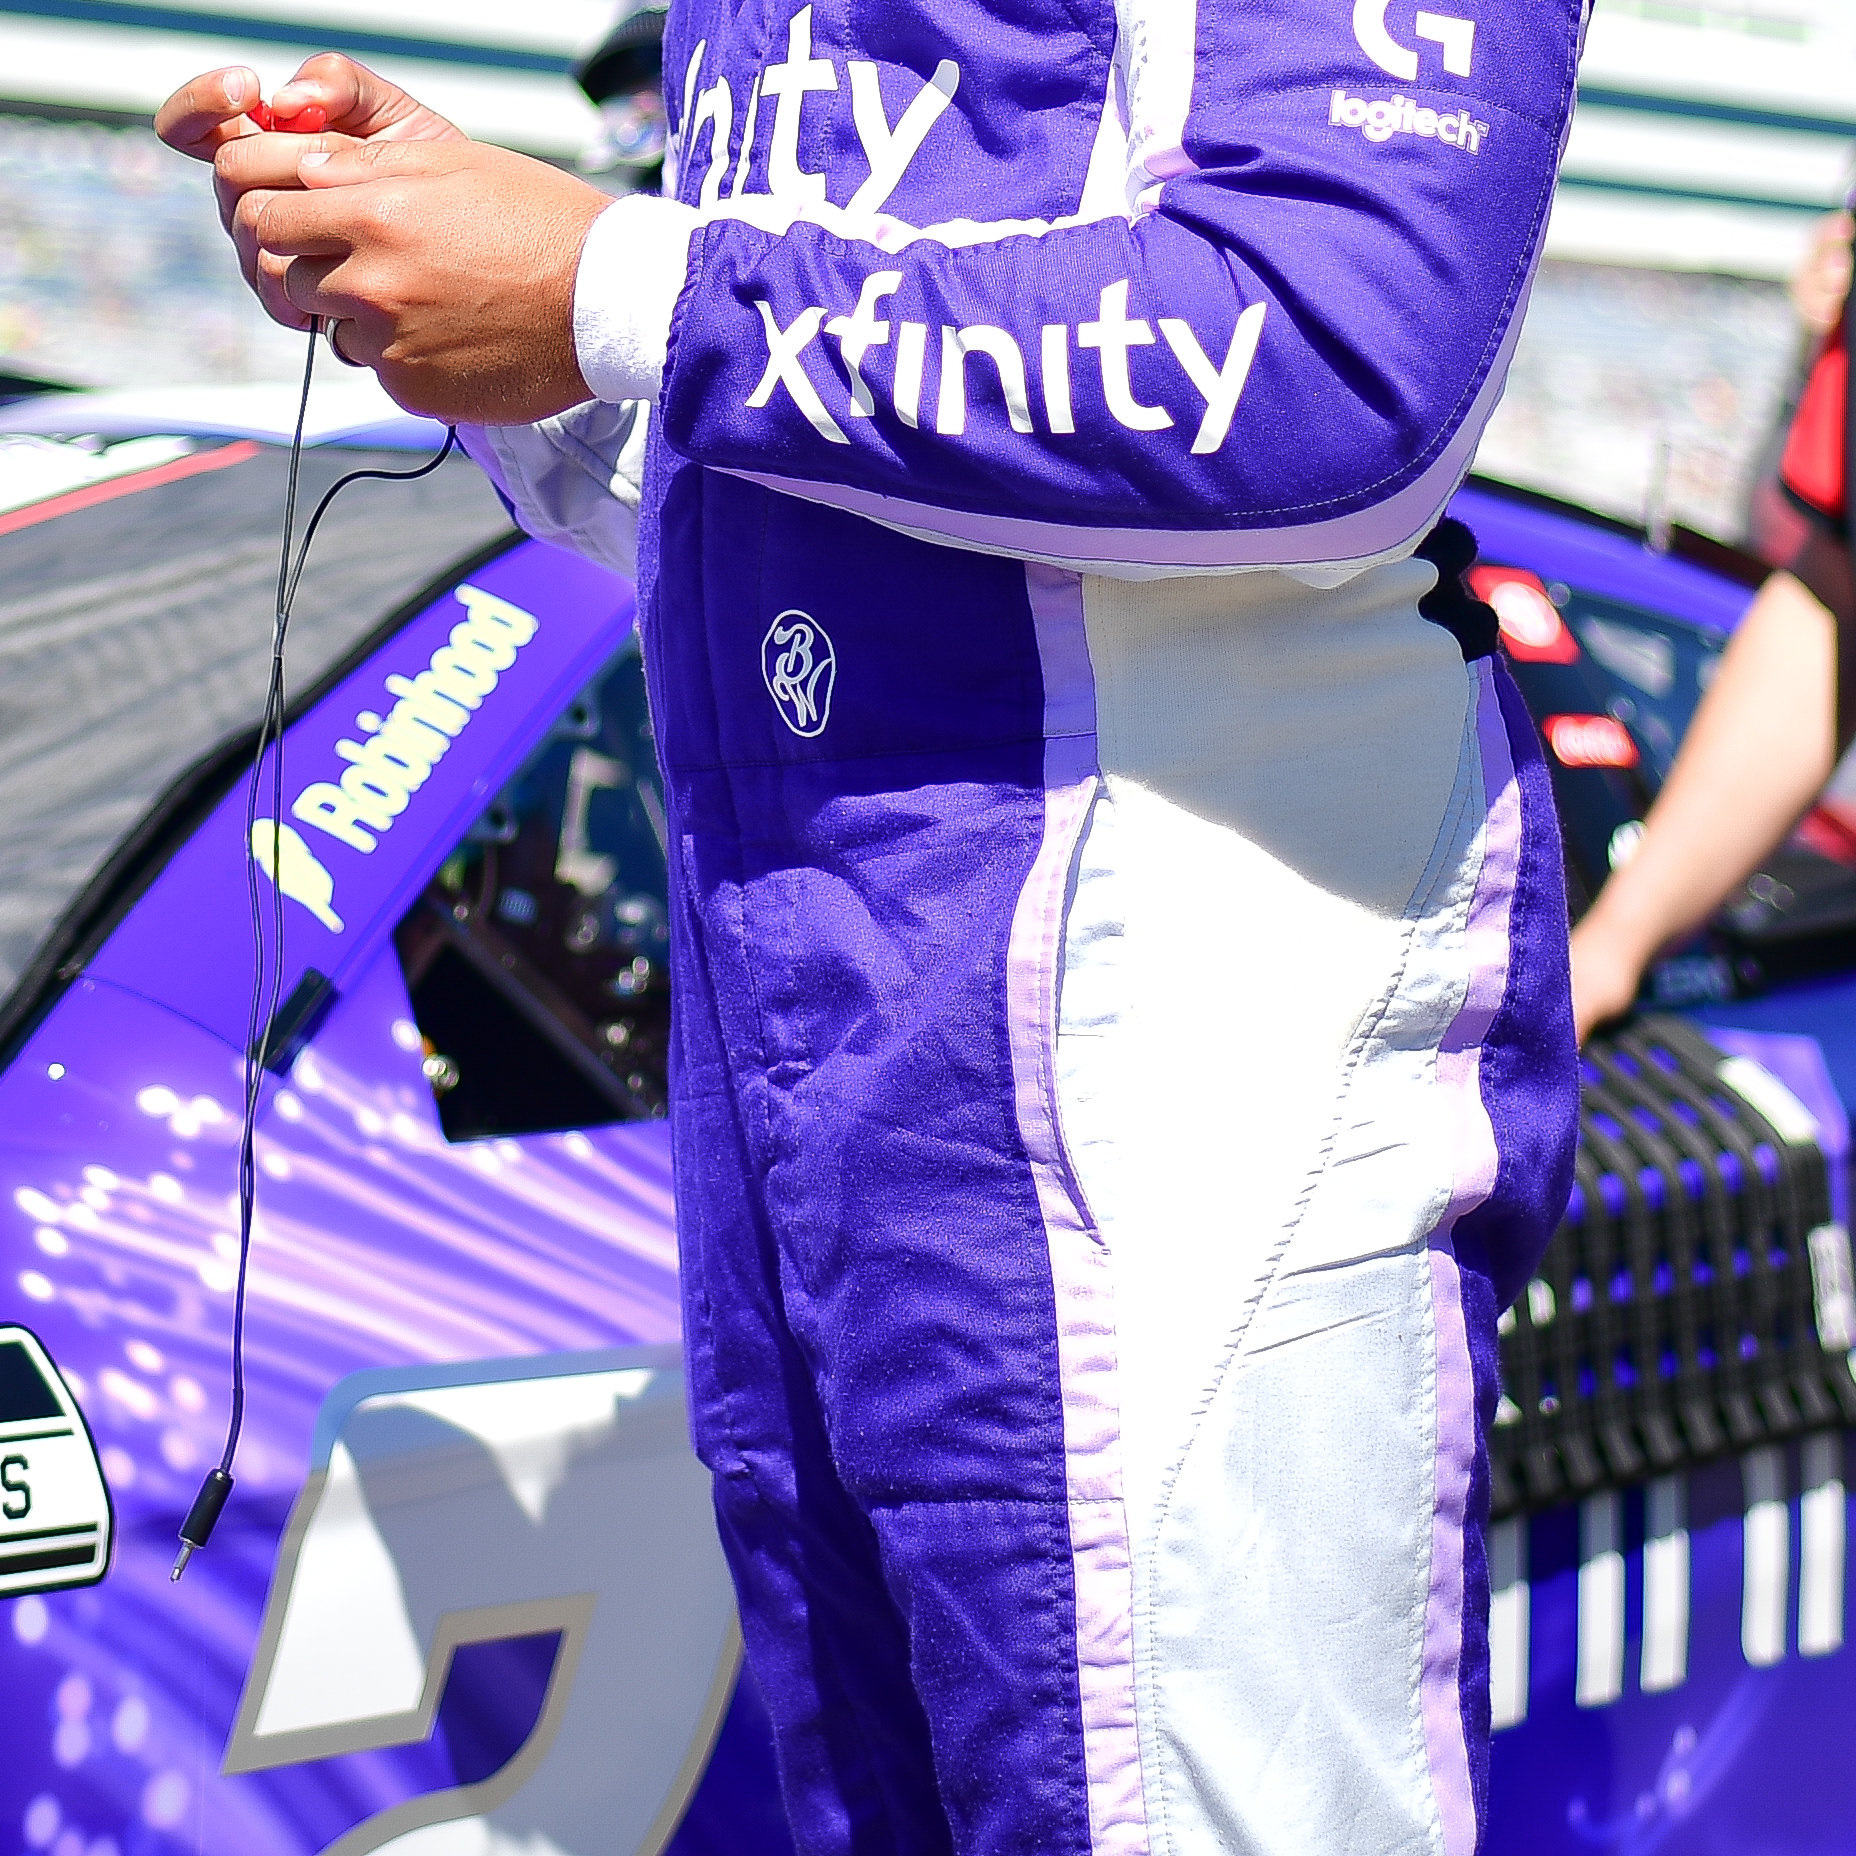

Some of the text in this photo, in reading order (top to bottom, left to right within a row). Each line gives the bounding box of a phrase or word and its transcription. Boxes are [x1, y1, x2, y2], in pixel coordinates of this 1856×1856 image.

[1328, 89, 1484, 155] logitech
[744, 270, 1268, 455] xfinity
[291, 583, 541, 856] Robinhood
